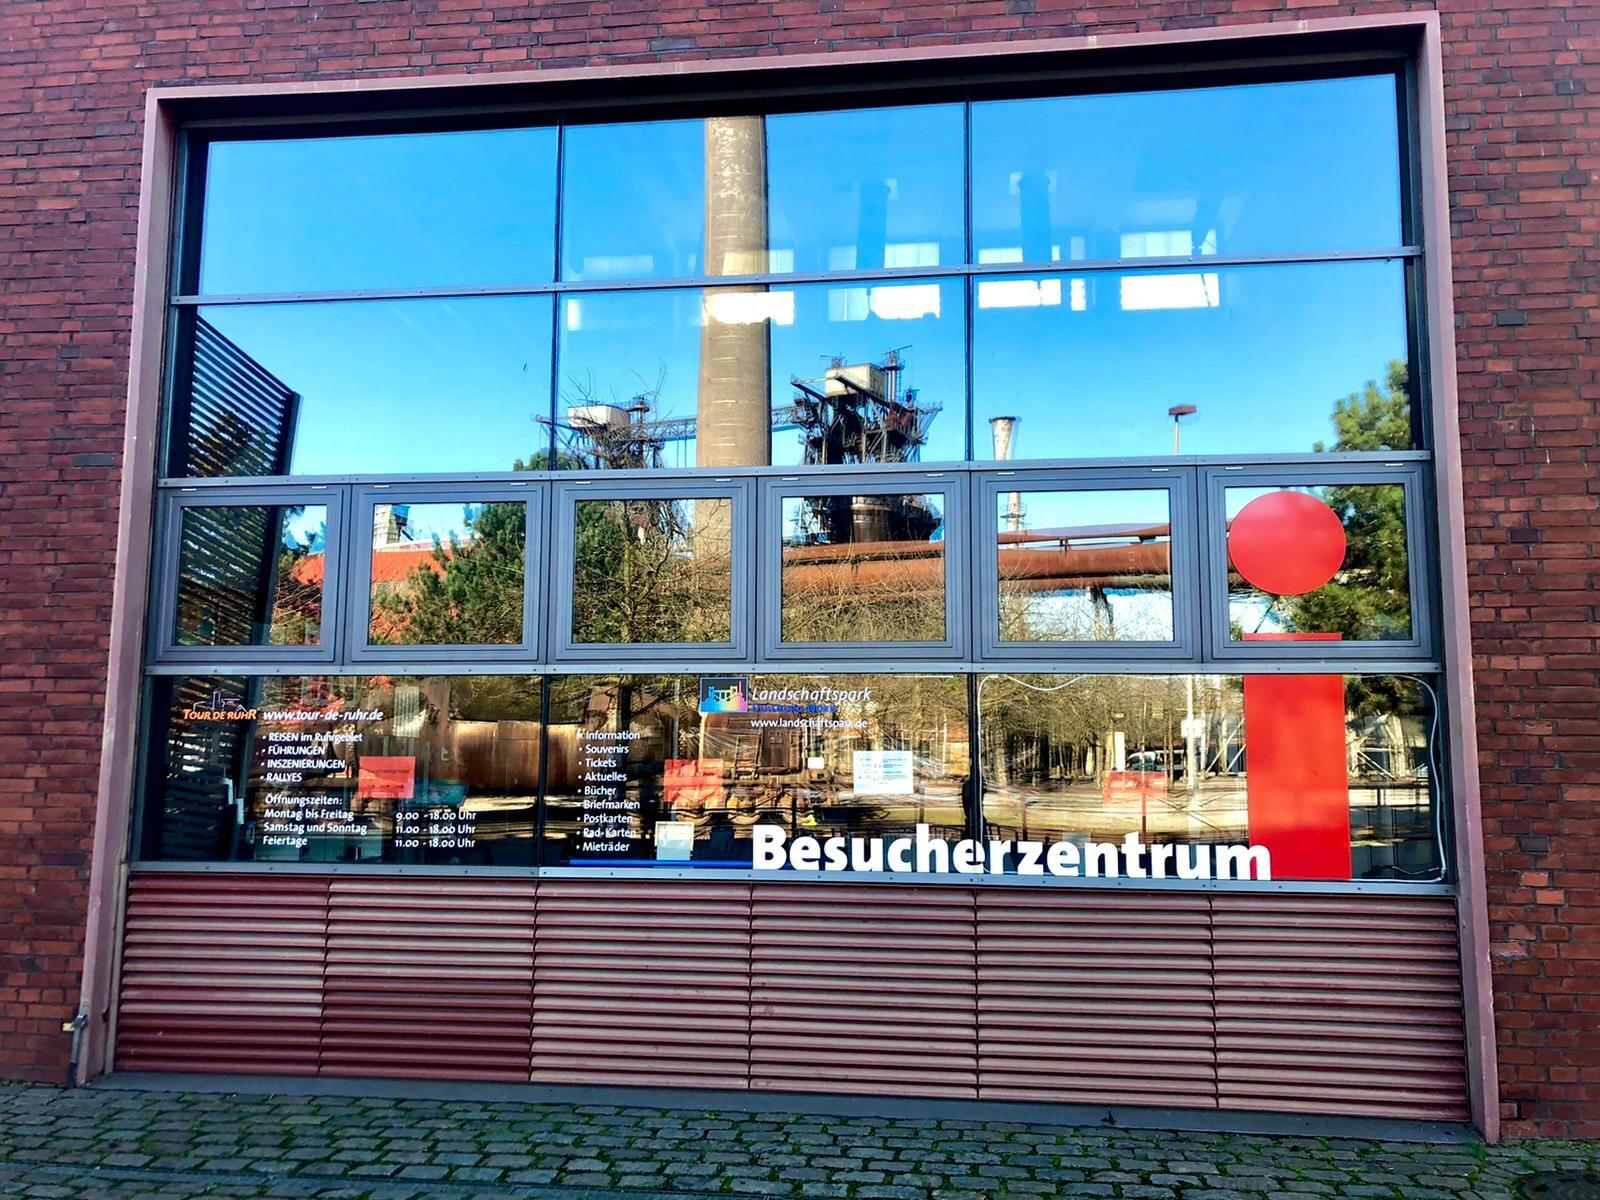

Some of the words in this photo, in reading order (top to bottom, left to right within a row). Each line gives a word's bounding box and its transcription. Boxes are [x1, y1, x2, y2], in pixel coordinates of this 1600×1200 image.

[752, 687, 871, 704] Landschaftspark
[212, 711, 226, 720] DE
[227, 709, 257, 720] RUHR
[263, 709, 384, 721] www.tour-de-ruhr.de
[751, 718, 868, 729] www.landschaftspark.de
[269, 732, 299, 742] REISEN
[301, 732, 312, 742] im
[314, 733, 363, 744] Ruhrgebiet
[586, 730, 640, 740] Information
[268, 745, 325, 755] FÜHRUNGEN
[586, 744, 629, 754] Souvenirs
[267, 759, 345, 769] INSZENIERUNGEN
[586, 758, 616, 768] Tickets
[267, 773, 302, 783] RALLYES
[584, 772, 627, 781] Aktuelles
[584, 786, 616, 795] Bücher
[265, 794, 343, 807] Öffnungszeiten:
[583, 800, 640, 809] Briefmarken
[264, 810, 302, 821] Montag
[305, 810, 319, 819] bis
[321, 811, 354, 821] Freitag
[396, 813, 419, 822] 9.00
[458, 811, 476, 820] Uhr
[583, 814, 633, 823] Postkarten
[263, 822, 305, 834] Samstag
[306, 823, 325, 832] und
[327, 823, 367, 835] Sonntag
[395, 825, 420, 834] 11.00
[458, 824, 476, 834] Uhr
[583, 828, 637, 838] Rad-Karten
[263, 836, 308, 847] Feiertage
[395, 839, 419, 848] 11.00
[458, 838, 476, 848] Uhr
[583, 842, 630, 852] Mieträder
[752, 823, 1271, 880] Besucherzentrum
